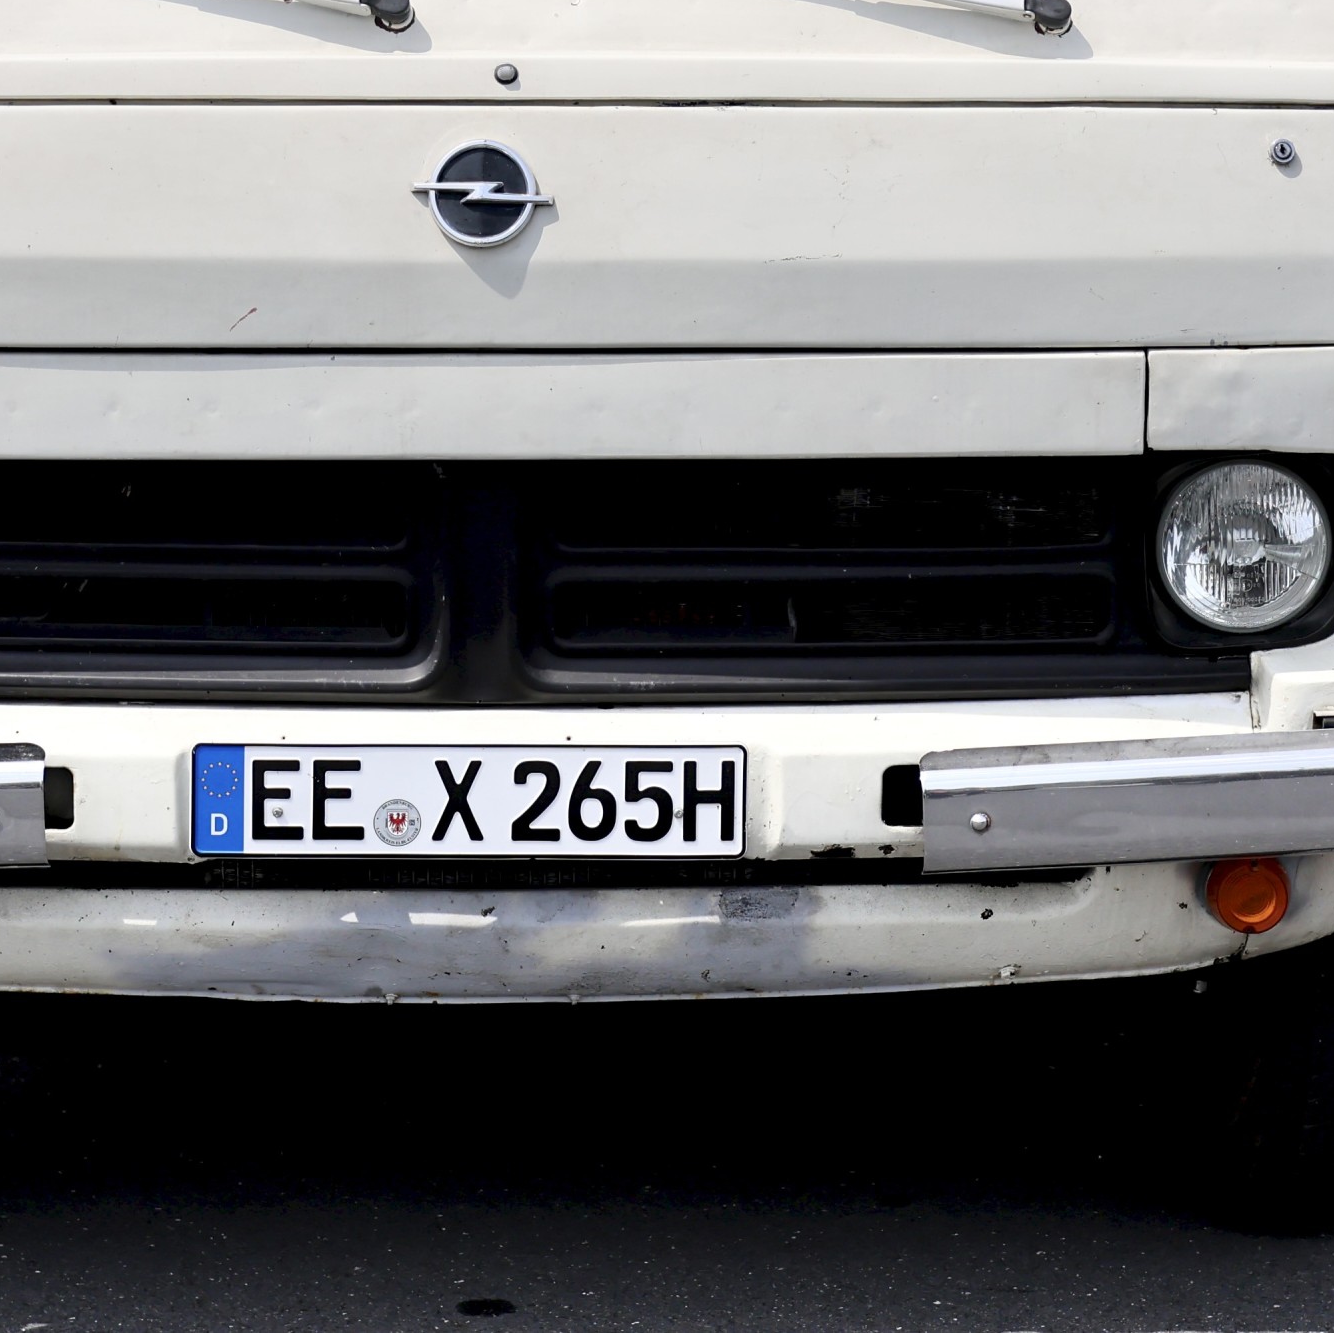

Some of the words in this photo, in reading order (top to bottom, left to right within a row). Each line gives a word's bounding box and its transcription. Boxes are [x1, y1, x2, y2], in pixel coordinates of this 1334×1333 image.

[210, 813, 228, 836] D
[252, 759, 365, 840] EE
[431, 760, 485, 841] X
[511, 760, 736, 842] 265H
